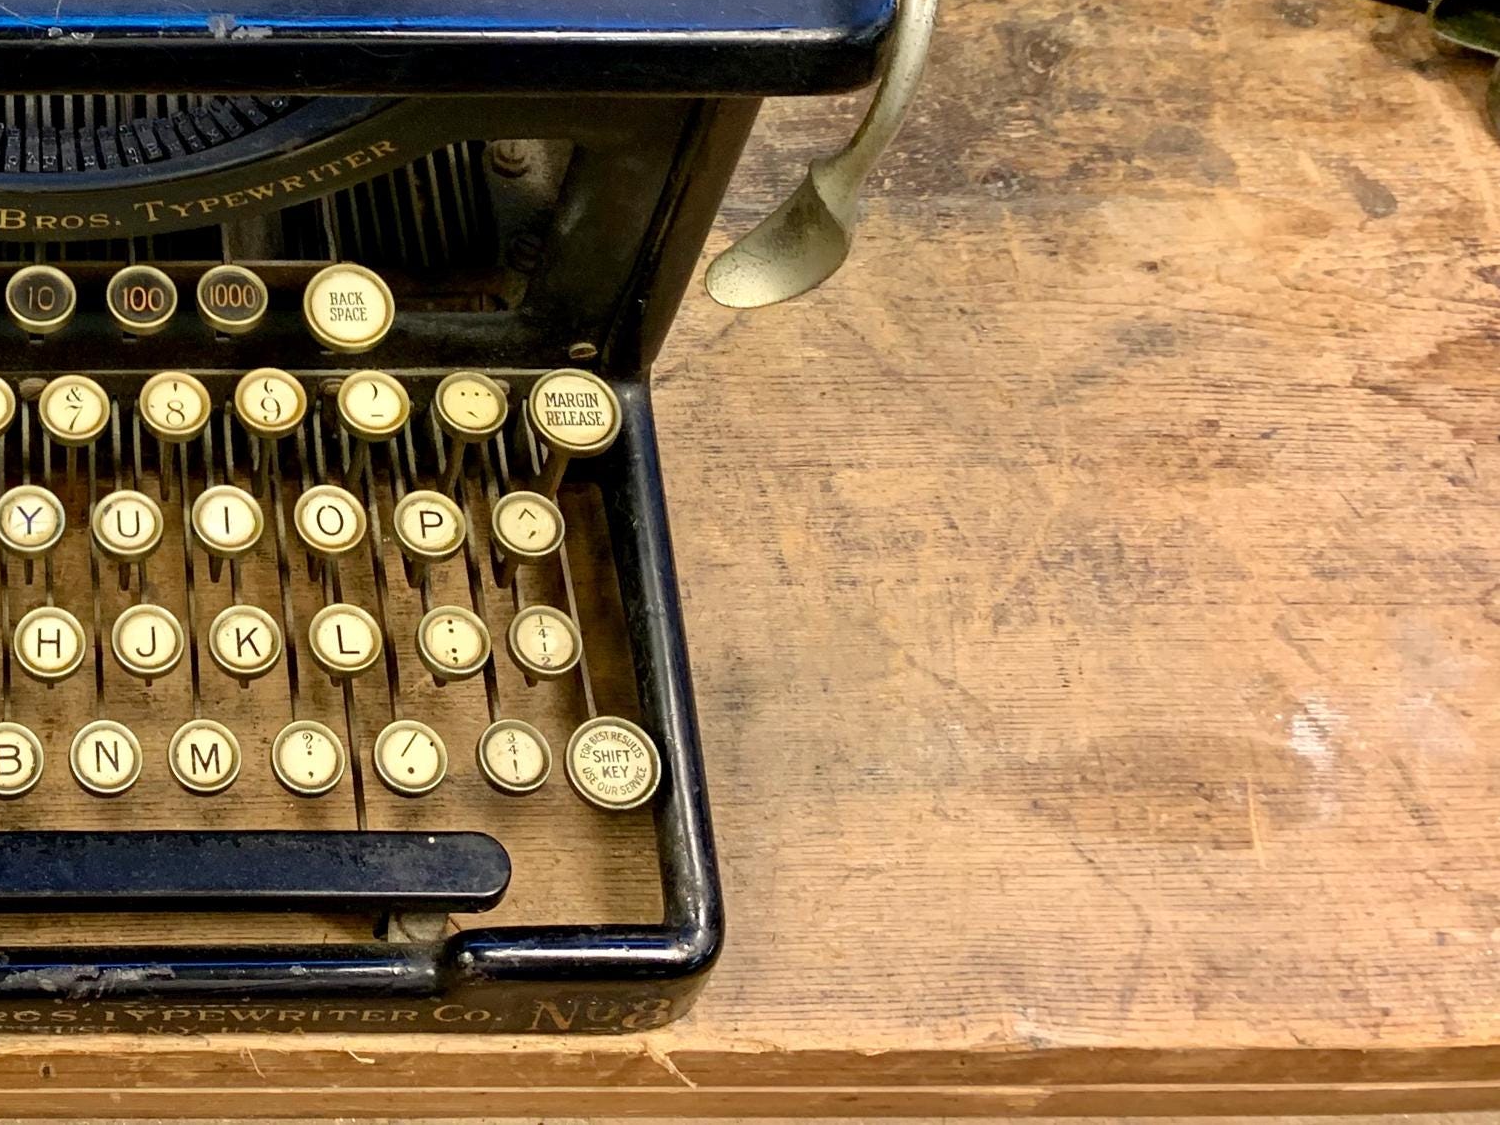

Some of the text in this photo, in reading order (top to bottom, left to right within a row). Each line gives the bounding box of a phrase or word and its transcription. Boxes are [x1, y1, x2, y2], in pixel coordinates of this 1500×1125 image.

[28, 286, 55, 310] 10
[122, 286, 165, 312] 100
[209, 283, 257, 308] 1000
[329, 292, 364, 306] BACK
[330, 307, 367, 322] SPACE
[166, 400, 185, 425] 8
[260, 397, 281, 421] 9
[545, 392, 599, 408] MARGIN
[65, 406, 84, 431] 7
[546, 410, 605, 427] RELEASE
[17, 505, 43, 536] Y
[116, 510, 141, 538] U
[316, 505, 344, 536] O
[419, 510, 444, 539] P
[37, 627, 61, 659] H
[136, 626, 157, 658] J
[235, 627, 262, 658] K
[336, 624, 361, 655] L
[94, 740, 119, 773] N
[580, 731, 644, 759] FOR BEST RESULTS
[593, 750, 630, 763] SHIFT
[191, 743, 221, 775] M
[602, 765, 629, 778] KEY
[583, 766, 647, 795] USE OUR SERVICE
